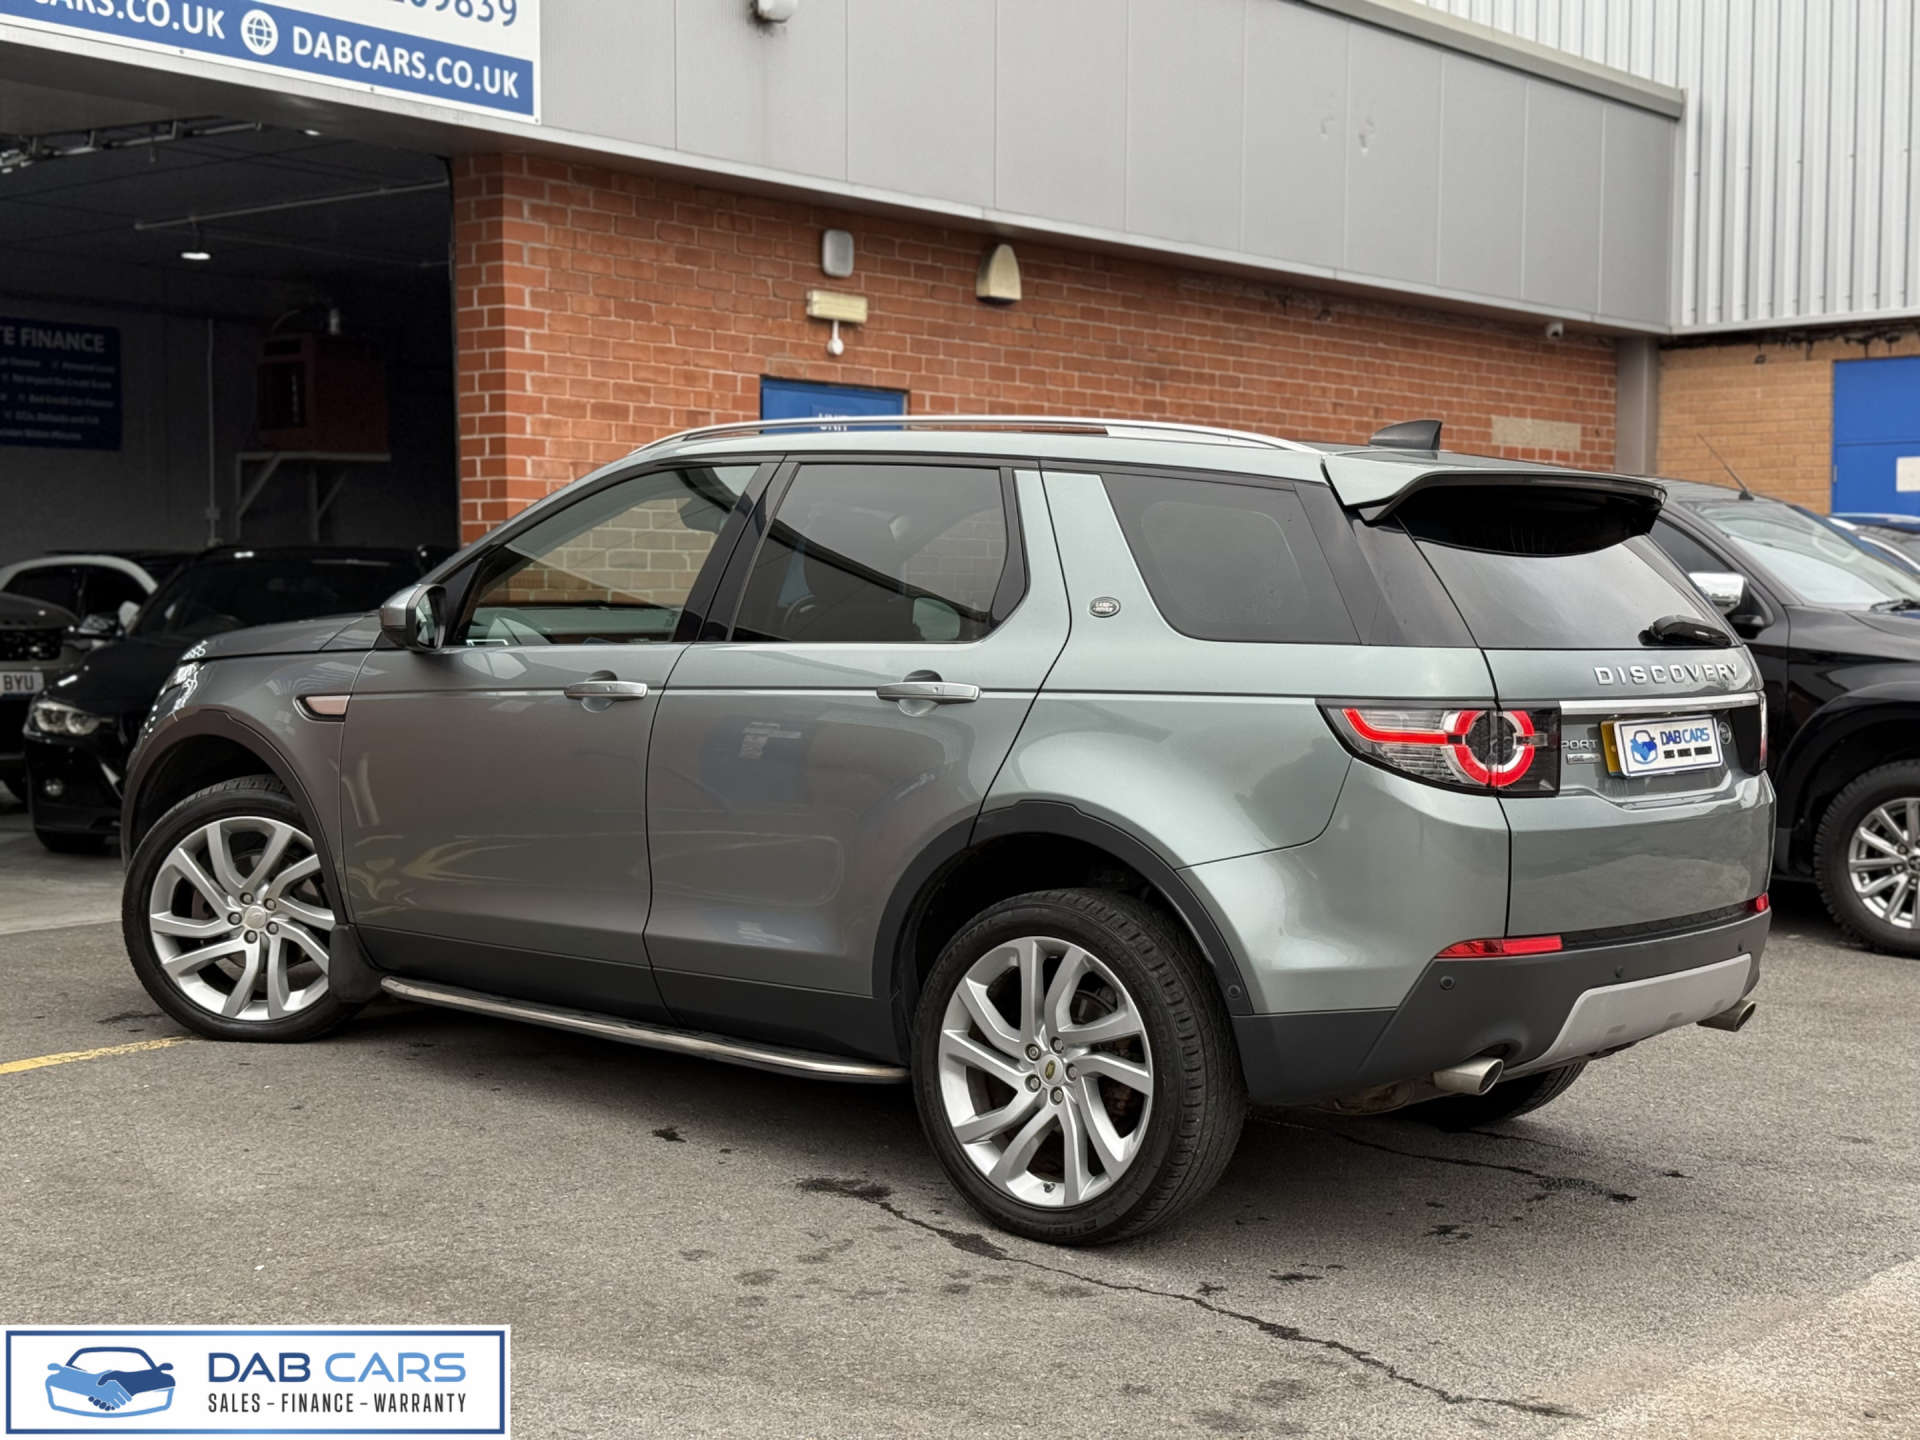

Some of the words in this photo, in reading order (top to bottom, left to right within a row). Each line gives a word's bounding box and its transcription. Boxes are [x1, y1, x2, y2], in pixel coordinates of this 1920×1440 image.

[34, 0, 225, 40] S.CO.UK
[292, 26, 519, 98] DABCARS.CO.UK
[0, 325, 16, 346] E
[20, 327, 105, 353] FINANCE
[3, 674, 34, 691] BYU
[1593, 663, 1738, 686] DISCOVERY
[1660, 730, 1682, 745] DAB
[1682, 727, 1710, 744] CARS
